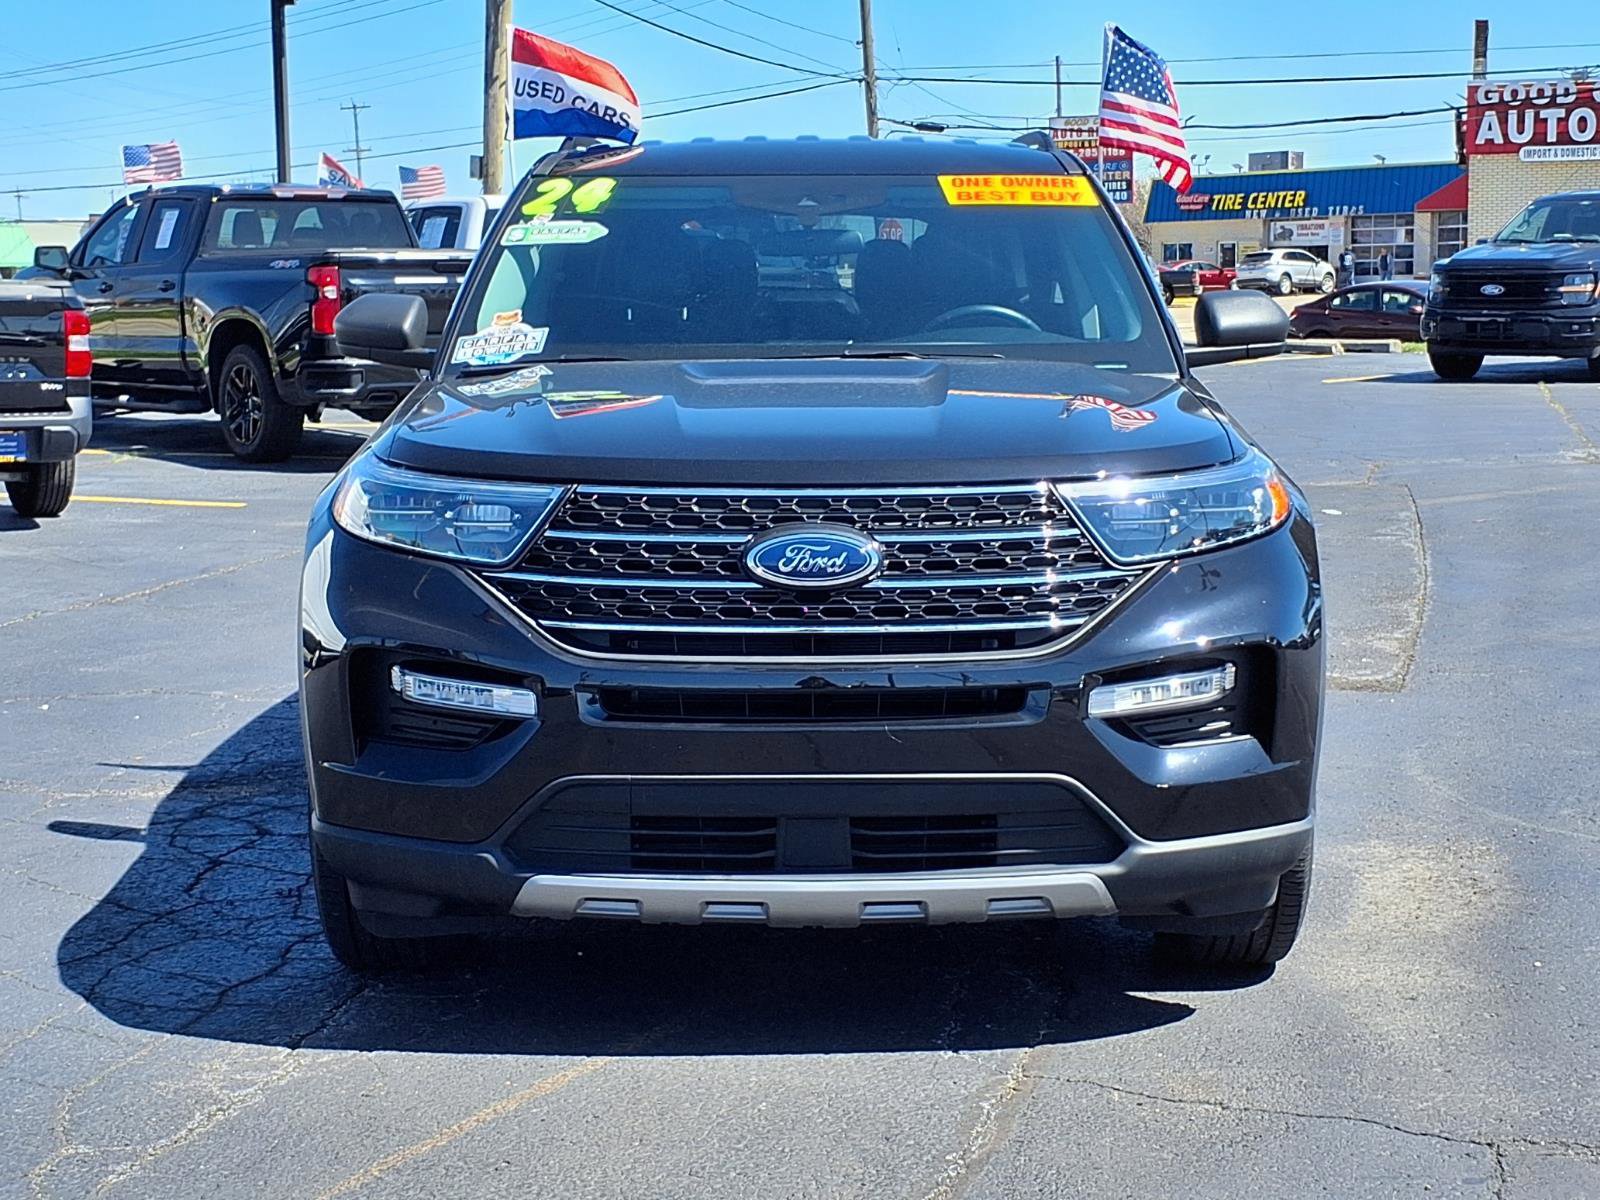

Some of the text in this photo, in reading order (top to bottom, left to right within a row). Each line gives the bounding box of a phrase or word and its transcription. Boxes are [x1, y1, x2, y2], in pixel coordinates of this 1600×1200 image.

[1477, 81, 1577, 105] GOOD
[514, 77, 631, 127] USED CARS
[1475, 107, 1597, 144] AUTO
[1523, 147, 1597, 159] IMPORT & DOMESTIC
[1093, 162, 1117, 170] CRE
[951, 177, 1075, 188] ONE OWNER
[956, 191, 1082, 202] BEST BUY
[1212, 191, 1306, 211] TIRE CENTER
[1290, 207, 1318, 217] USED
[778, 544, 849, 573] Ford
